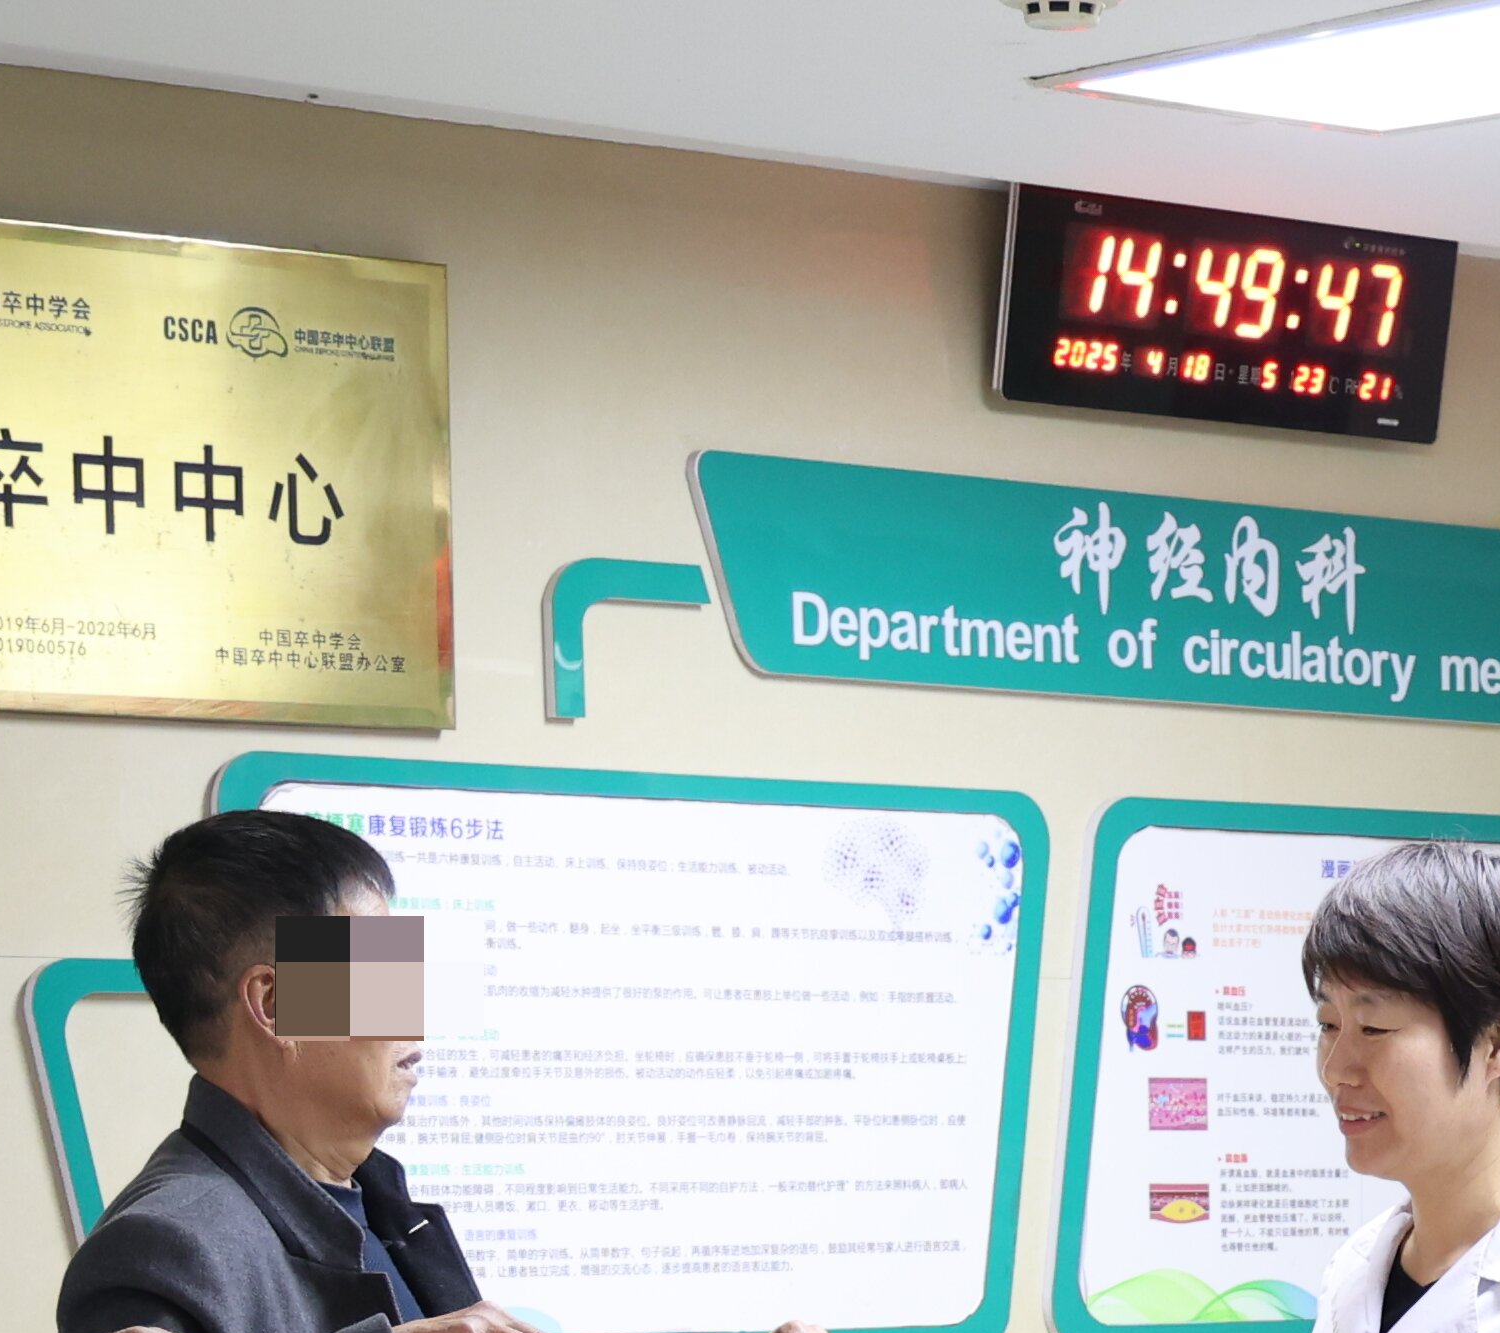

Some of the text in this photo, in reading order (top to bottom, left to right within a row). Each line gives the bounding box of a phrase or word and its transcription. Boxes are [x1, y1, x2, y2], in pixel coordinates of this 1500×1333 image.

[1088, 234, 1403, 348] 14:49:47
[163, 316, 218, 345] CSCA
[294, 327, 395, 353] 中国卒中中心联盟
[1053, 500, 1366, 635] 神经内科
[258, 628, 362, 651] 中国卒中学会
[791, 590, 1079, 666] Department
[1106, 618, 1158, 669] of
[1183, 625, 1417, 703] circulatory
[215, 646, 406, 675] 中国卒中中心联盟办公室
